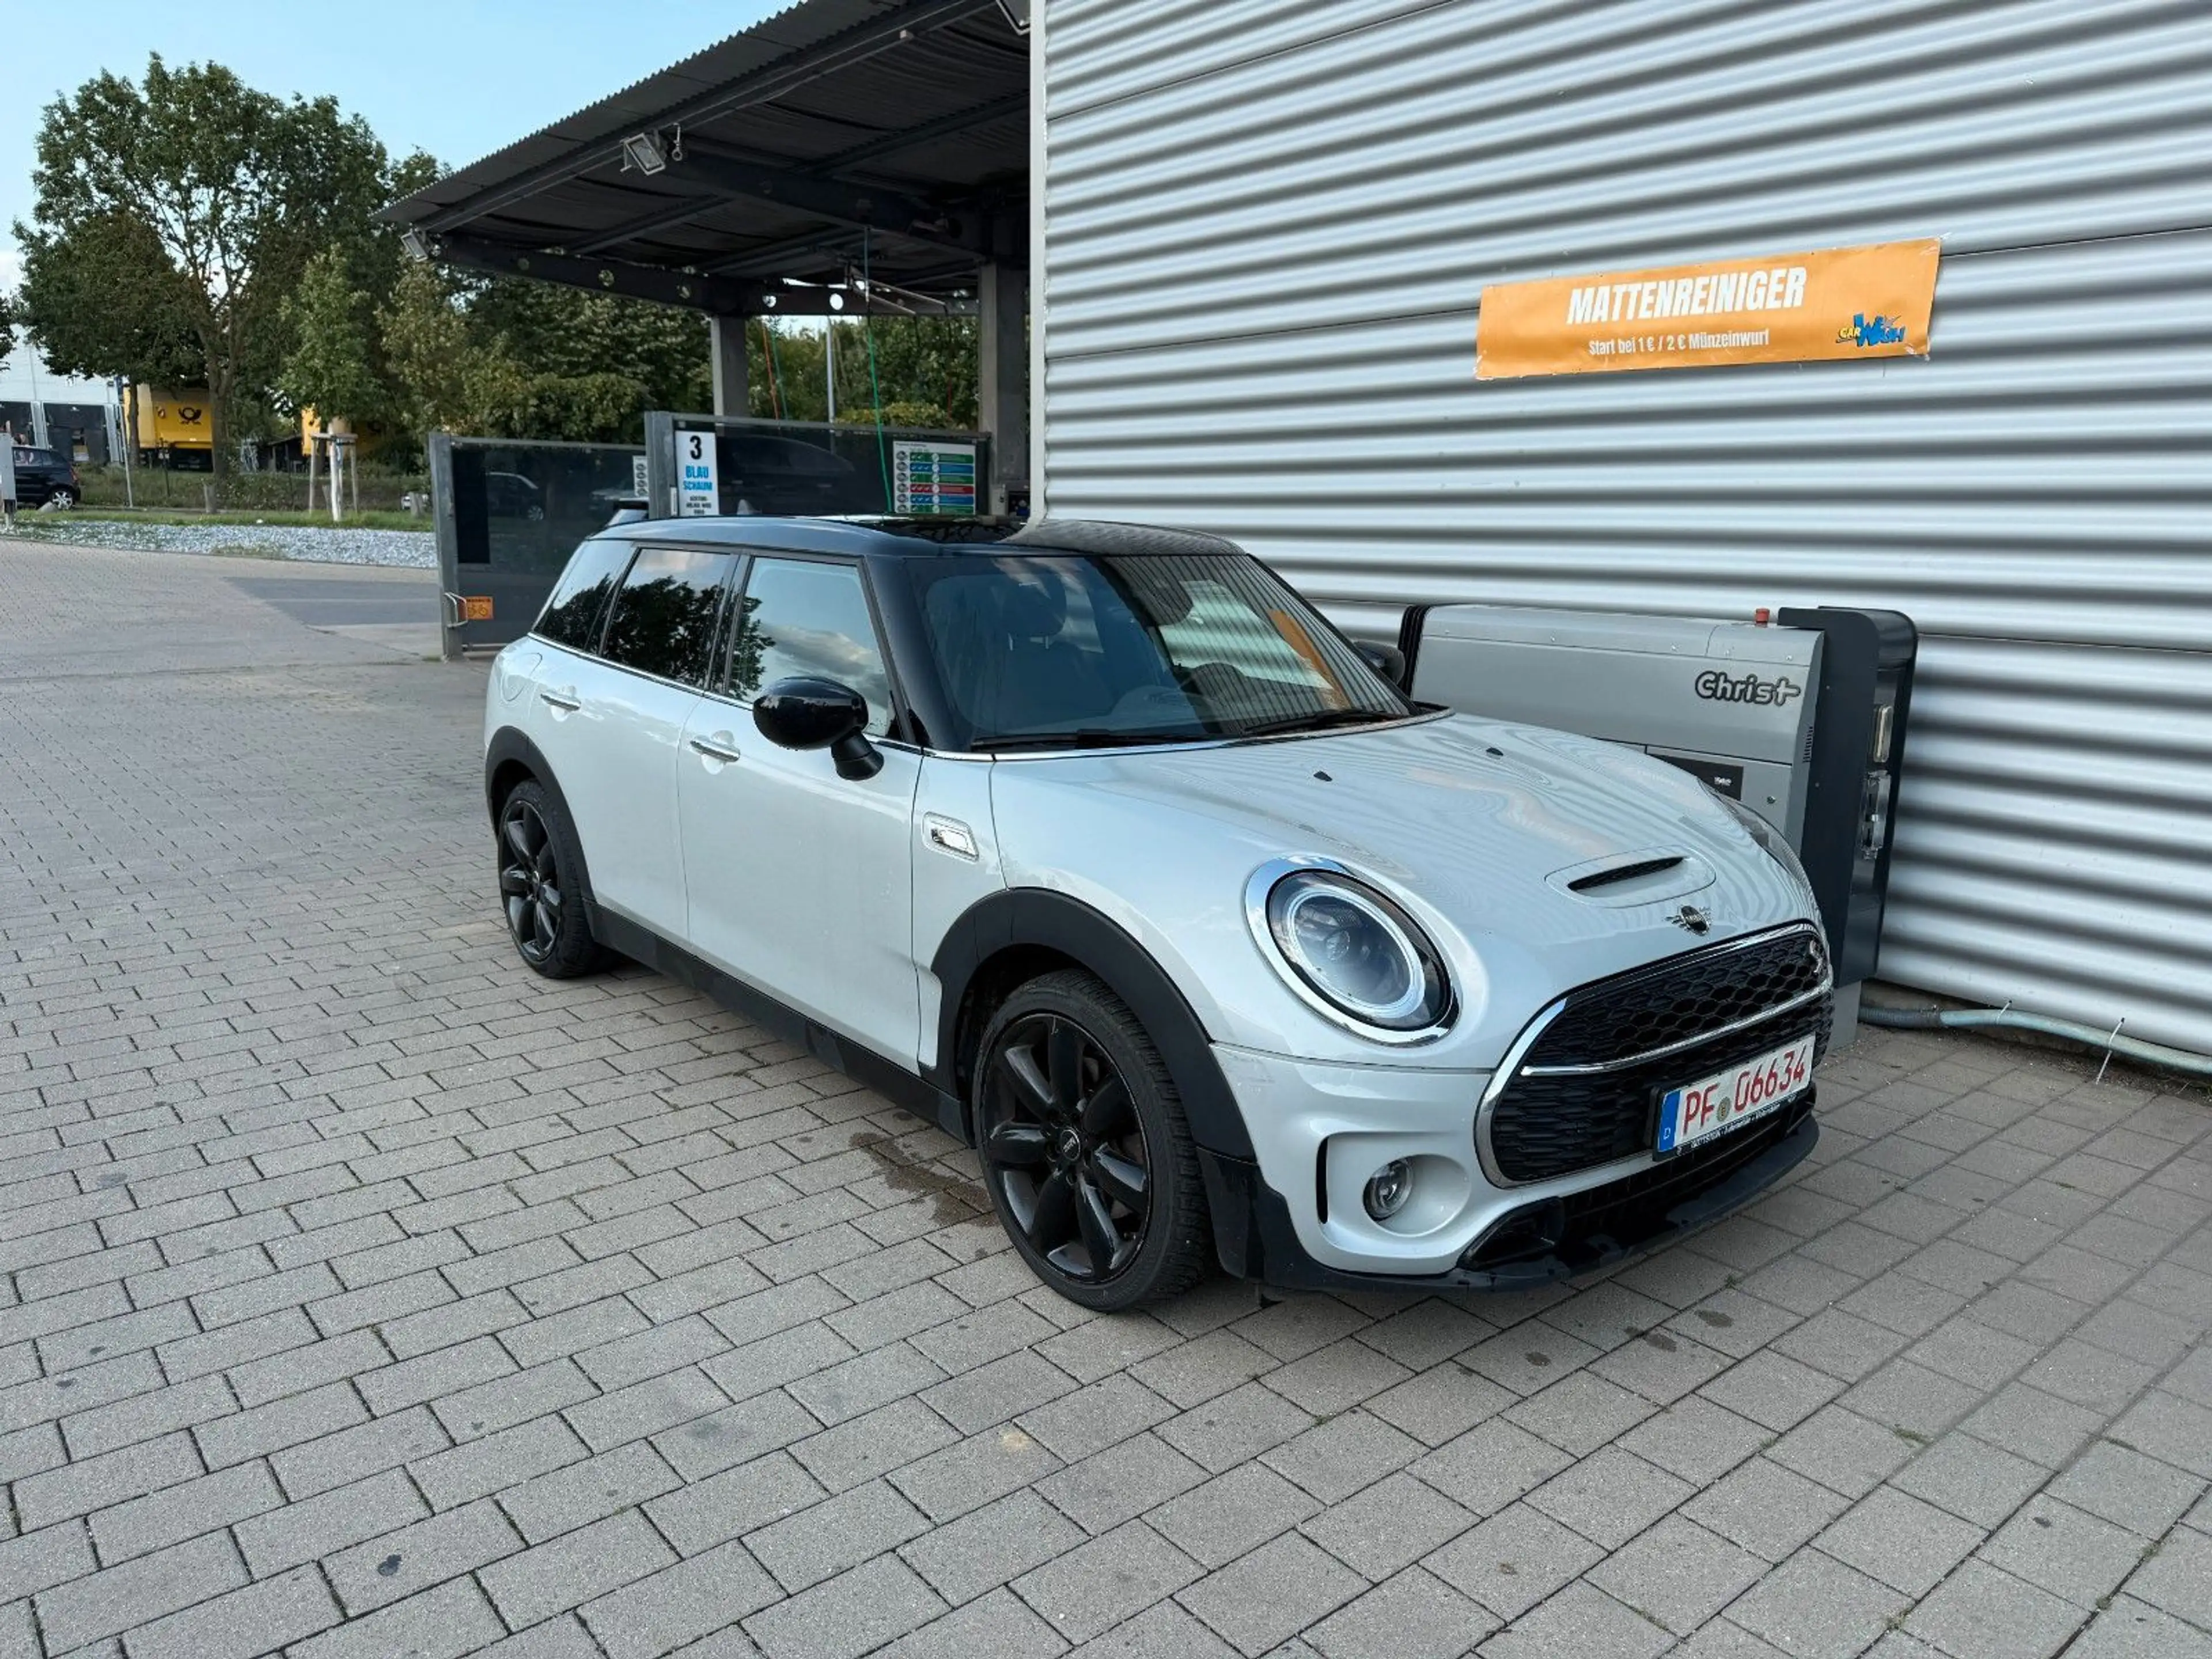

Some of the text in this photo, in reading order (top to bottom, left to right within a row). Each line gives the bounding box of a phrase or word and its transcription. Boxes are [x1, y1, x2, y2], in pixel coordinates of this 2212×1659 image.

[1566, 267, 1807, 325] MATTENREINIGER
[1589, 328, 1769, 355] Start bei 1 € / 2 € Münzeinwurf
[1838, 327, 1861, 339] CAR
[690, 435, 702, 460] 3
[685, 465, 709, 478] BLAU
[1695, 670, 1801, 706] Christ
[1683, 1082, 1720, 1134] PF
[1734, 1043, 1807, 1112] 06634
